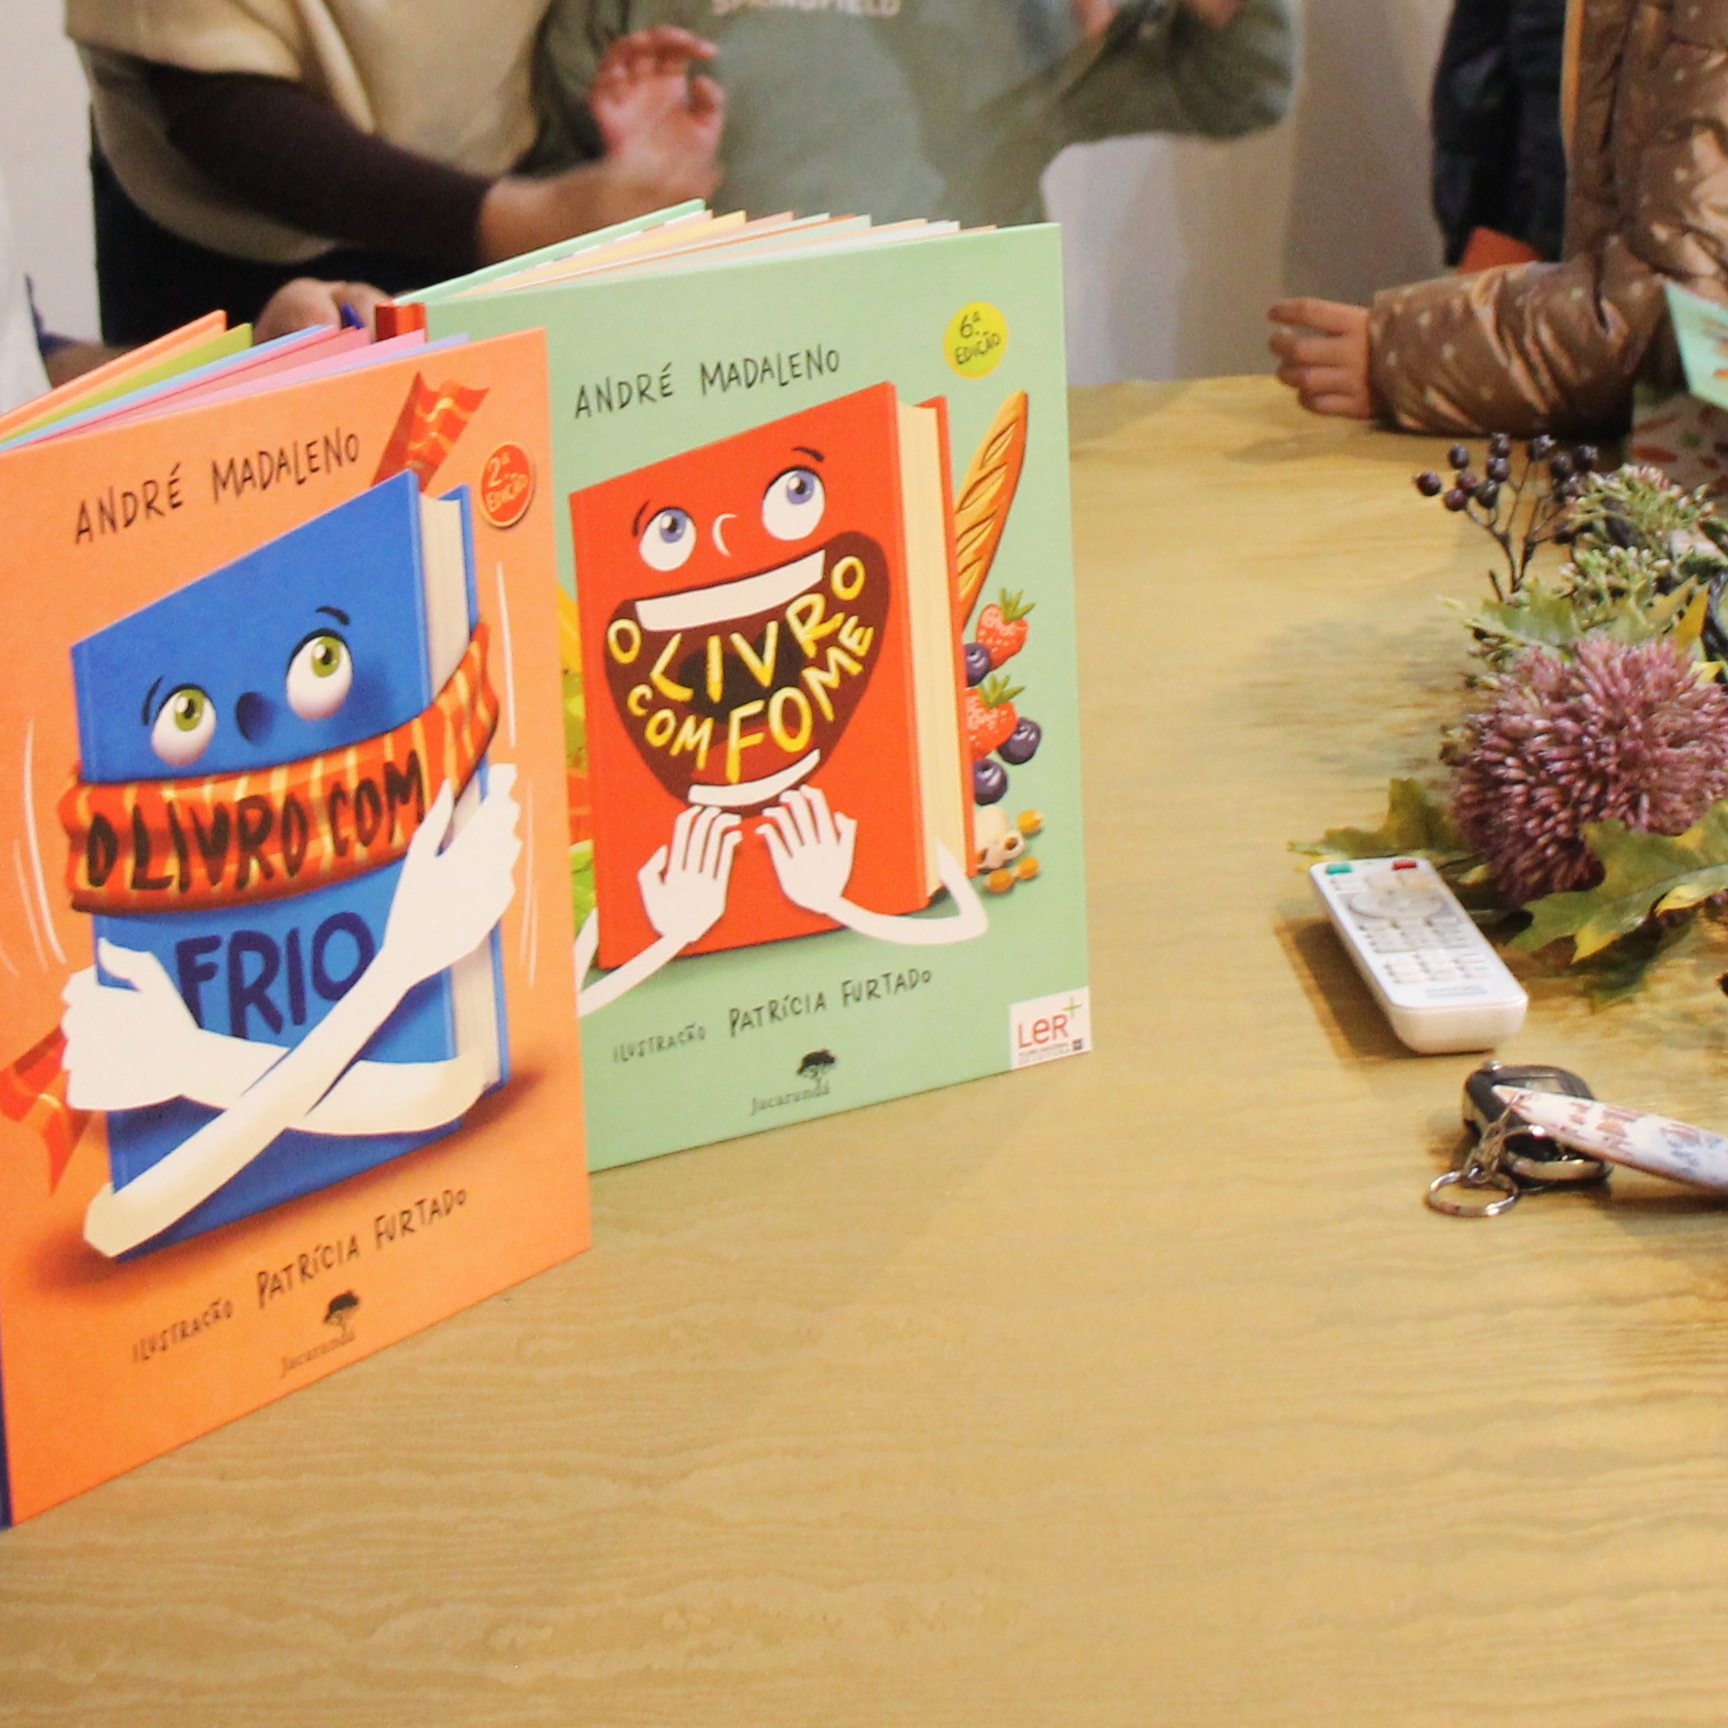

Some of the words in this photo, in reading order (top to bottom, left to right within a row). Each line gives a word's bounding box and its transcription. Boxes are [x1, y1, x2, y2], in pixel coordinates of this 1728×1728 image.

[574, 360, 675, 419] ANDRÉ
[699, 343, 841, 398] MADALENO
[74, 461, 184, 546] ANDRÉ
[210, 426, 360, 505] MADALENO
[607, 617, 642, 664] O
[650, 555, 866, 703] LIVRO
[626, 683, 714, 771] COM
[726, 615, 874, 784] FOME
[87, 812, 119, 888] O
[130, 793, 309, 894] LIVRO
[328, 748, 426, 859] COM
[175, 910, 376, 1040] FRIO
[728, 992, 829, 1039] PATRÍCIA
[840, 968, 933, 1010] FURTADO
[256, 1234, 360, 1310] PATRÍCIA
[374, 1188, 468, 1250] FURTADO
